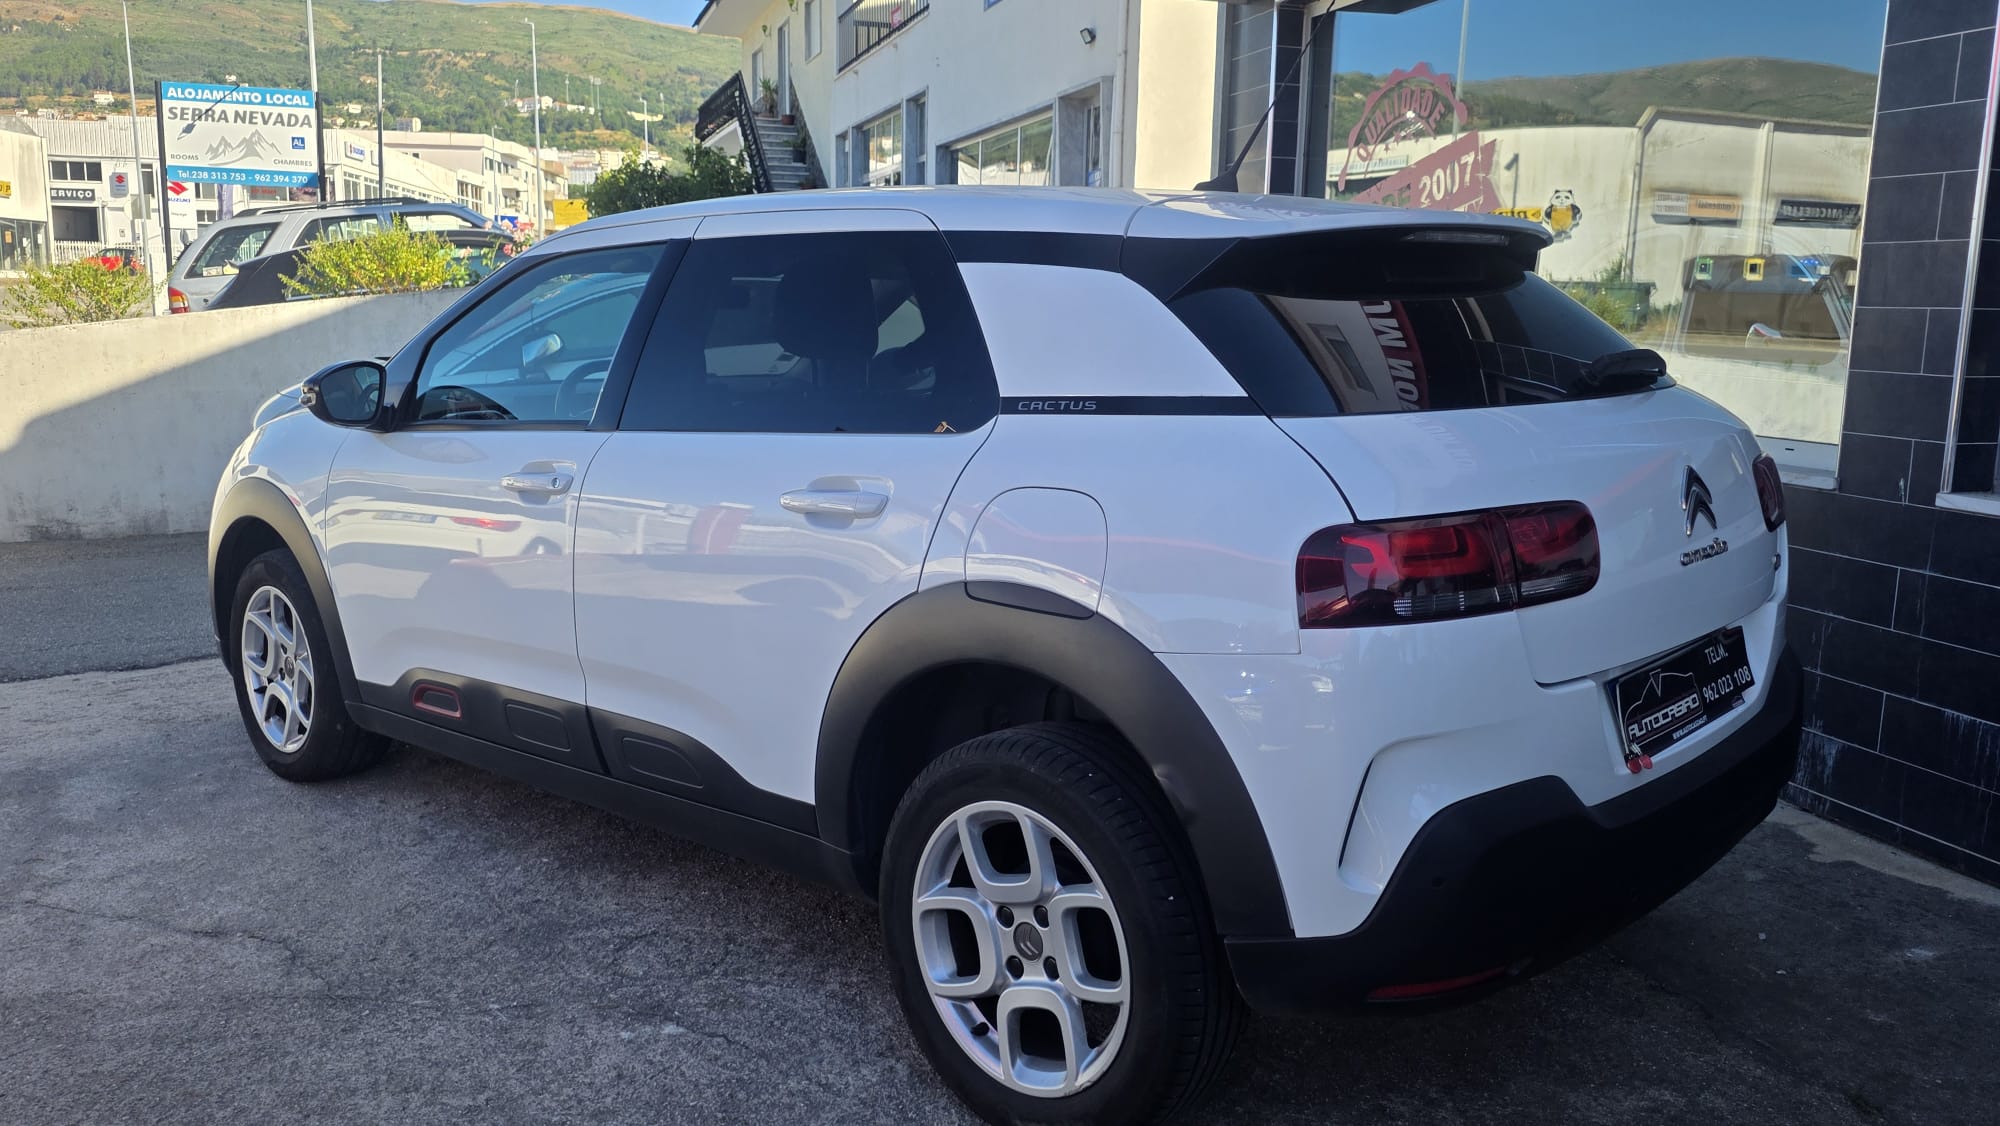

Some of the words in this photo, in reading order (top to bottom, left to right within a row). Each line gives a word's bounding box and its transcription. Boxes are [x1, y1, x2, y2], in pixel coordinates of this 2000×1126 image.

[167, 87, 262, 104] ALOJAMENTO
[266, 93, 310, 106] LOCAL
[168, 106, 229, 124] SERRA
[233, 110, 313, 129] NEVADA
[1357, 87, 1446, 162] QUALIDADE
[170, 153, 199, 161] ROOMS
[273, 158, 313, 167] CHAMBRES
[210, 171, 228, 180] 313
[230, 172, 246, 181] 753
[254, 173, 271, 183] 962
[273, 174, 289, 183] 394
[291, 175, 308, 184] 370
[51, 189, 92, 200] ERVIÇO
[1018, 400, 1097, 411] CACTUS
[1704, 643, 1729, 665] TELM.
[1702, 682, 1720, 703] 962
[1717, 674, 1734, 695] 023
[1733, 665, 1751, 687] 108
